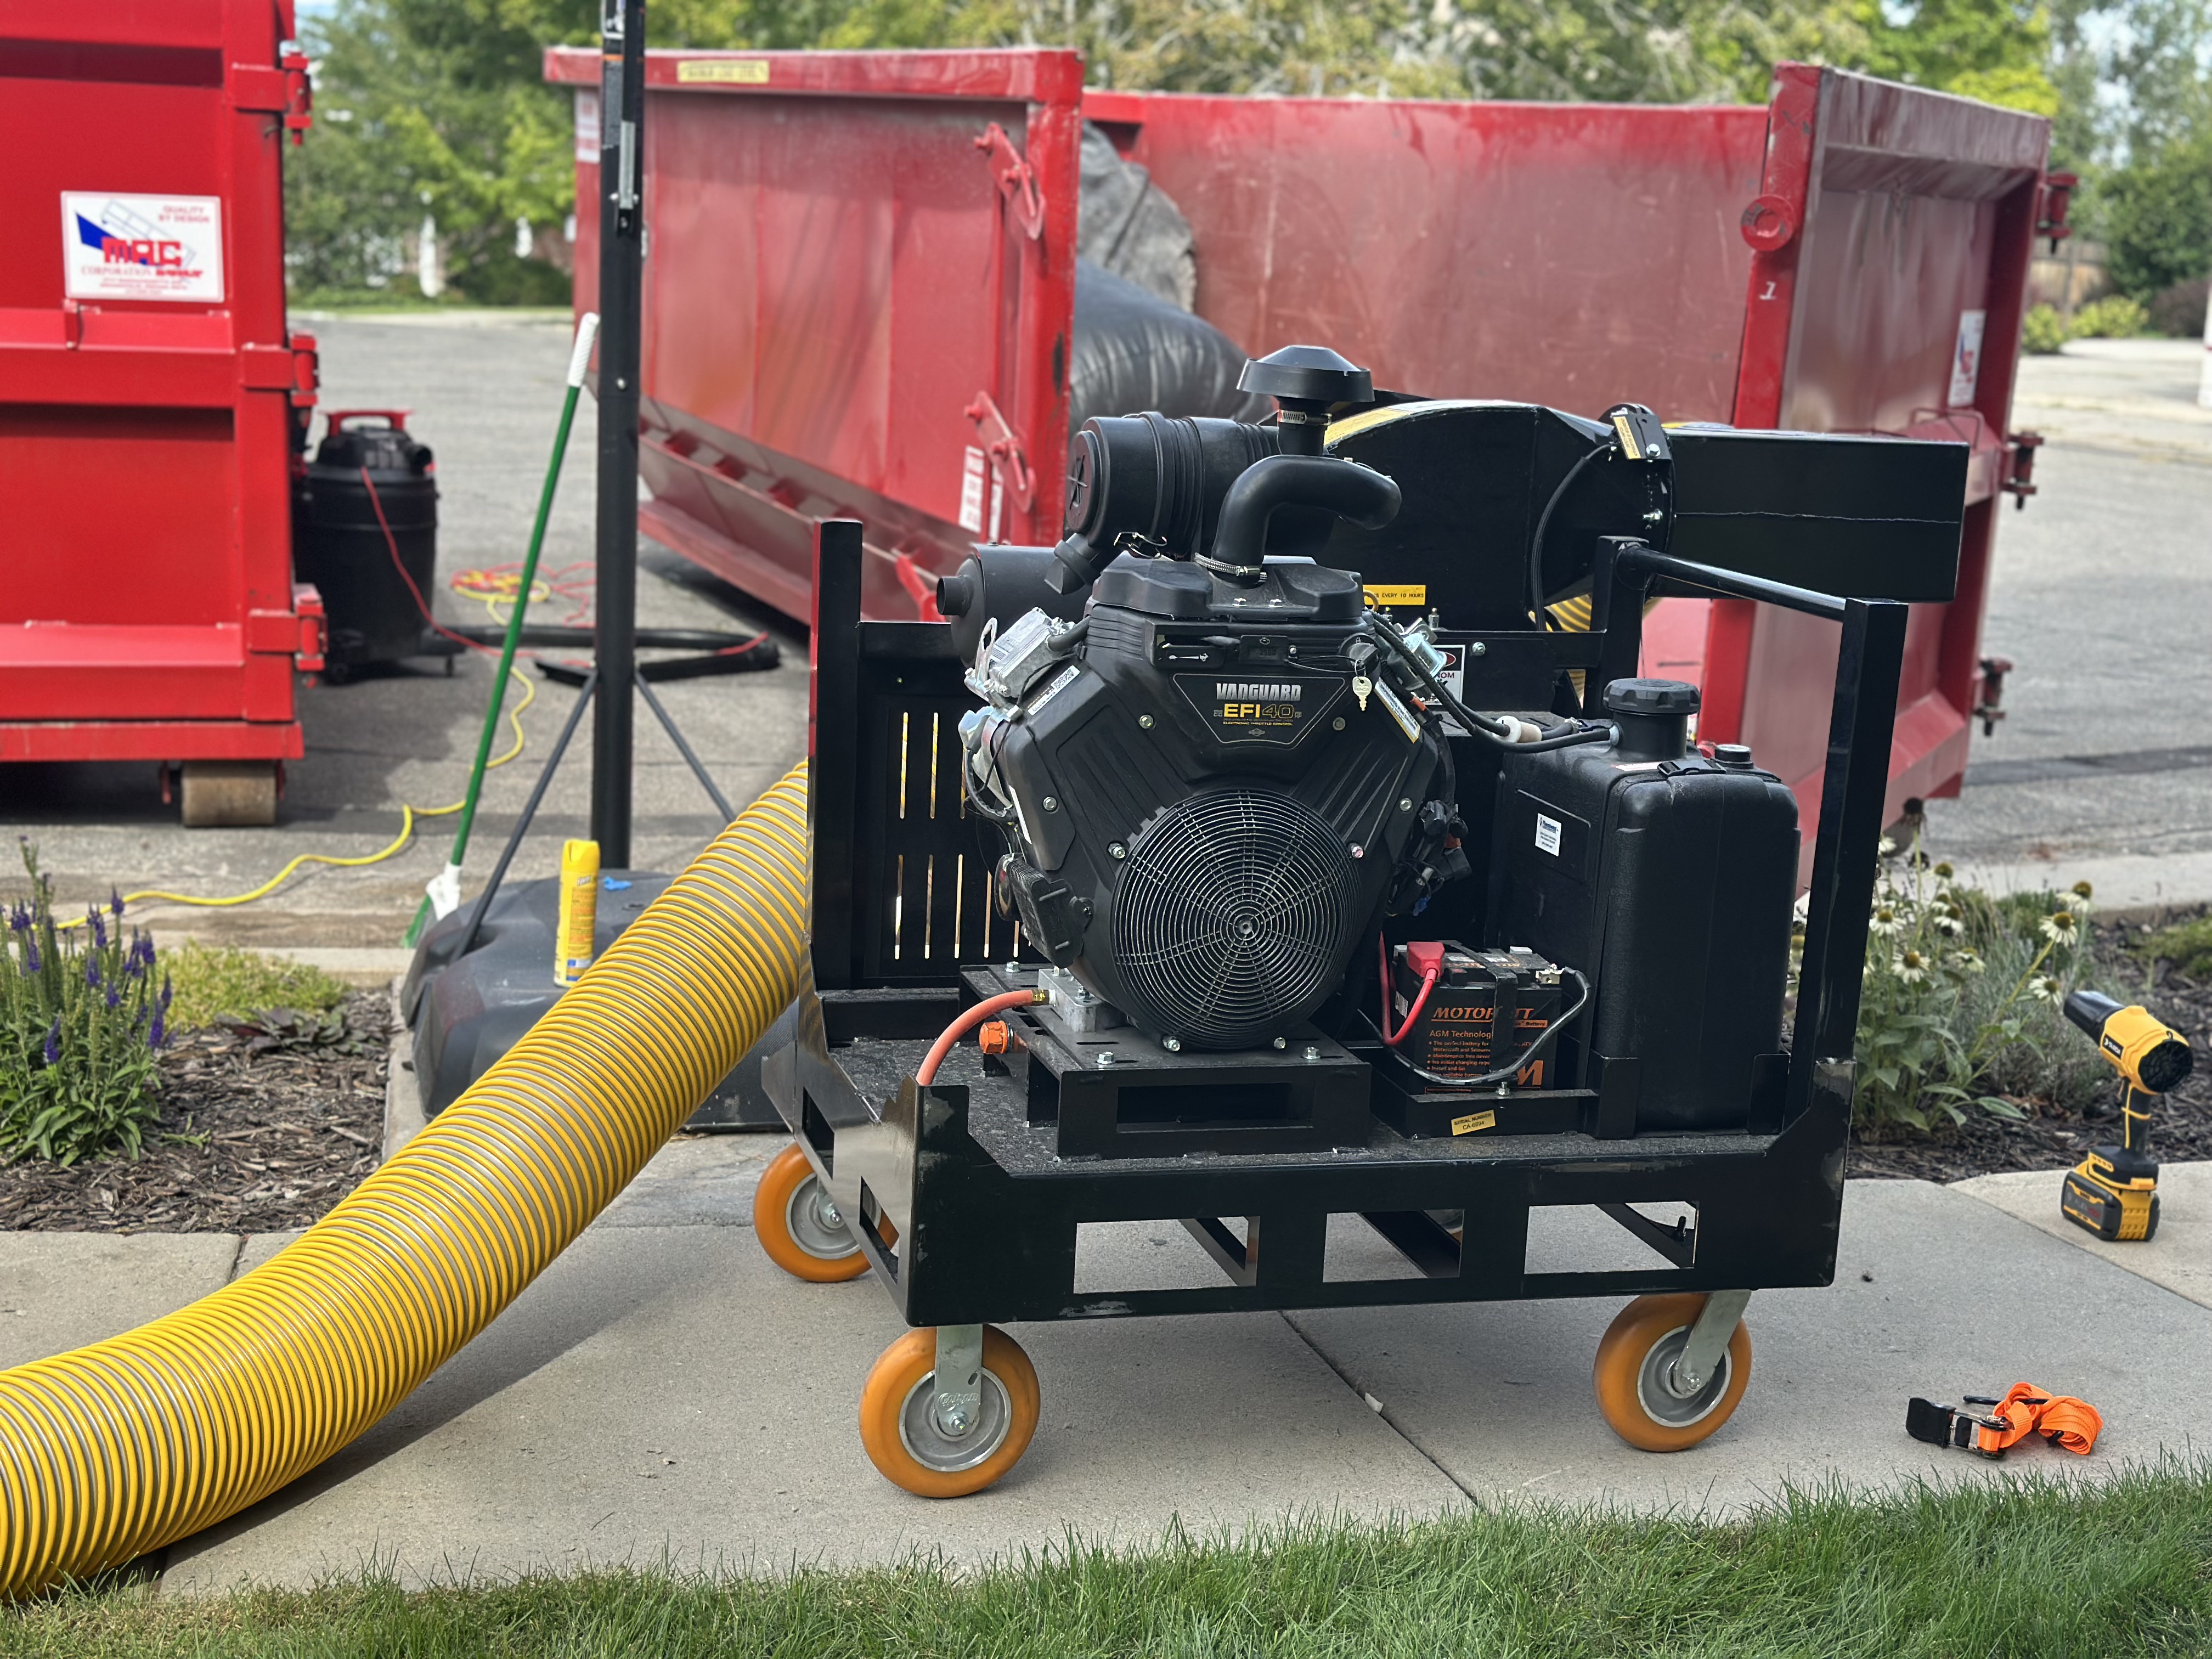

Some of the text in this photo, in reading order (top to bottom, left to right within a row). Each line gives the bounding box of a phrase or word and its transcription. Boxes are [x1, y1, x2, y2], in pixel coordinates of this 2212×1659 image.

[1216, 683, 1301, 701] VANGUARD
[1223, 703, 1294, 719] EFI 40
[1434, 1007, 1534, 1019] MOTOTT
[1452, 1030, 1492, 1040] Technolog
